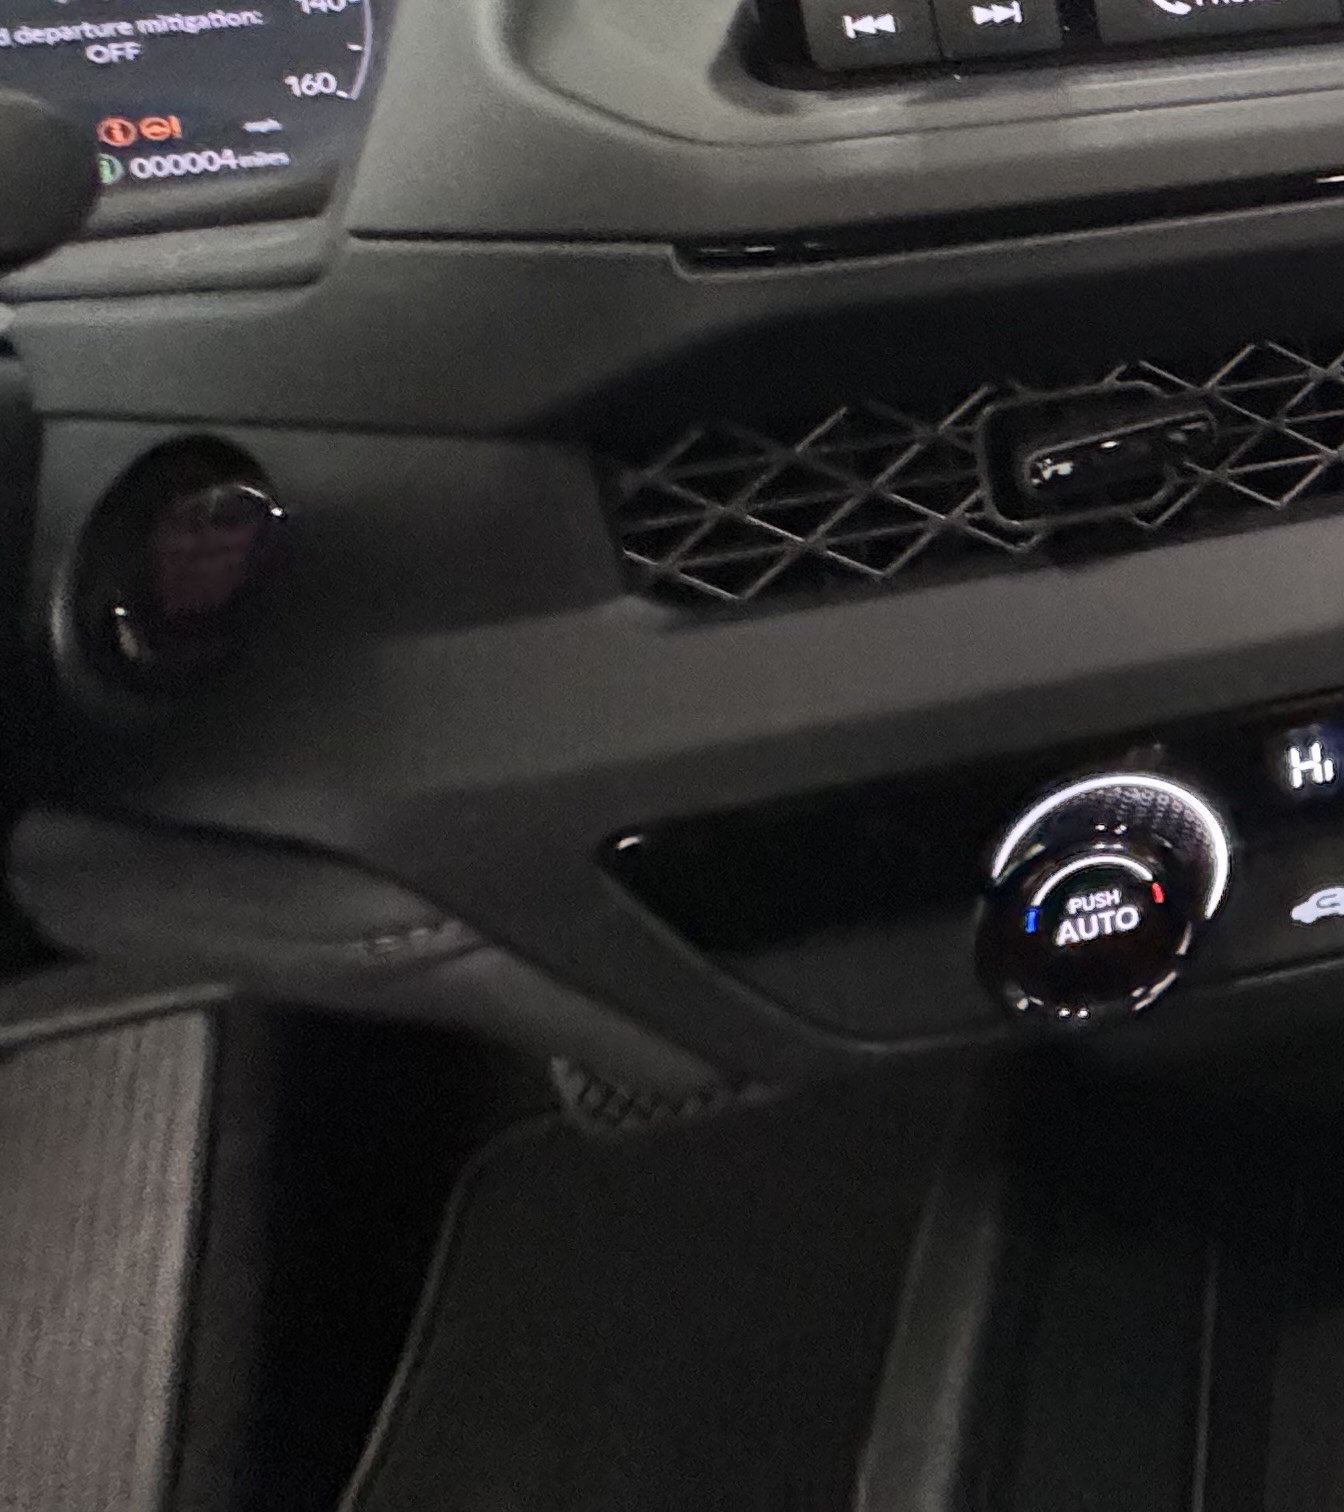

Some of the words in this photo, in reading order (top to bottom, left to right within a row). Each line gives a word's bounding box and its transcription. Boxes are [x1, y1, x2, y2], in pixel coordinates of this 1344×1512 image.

[85, 41, 142, 64] OFF
[284, 71, 336, 97] 160
[1066, 889, 1122, 915] PUSH
[1055, 906, 1141, 947] AUTO
